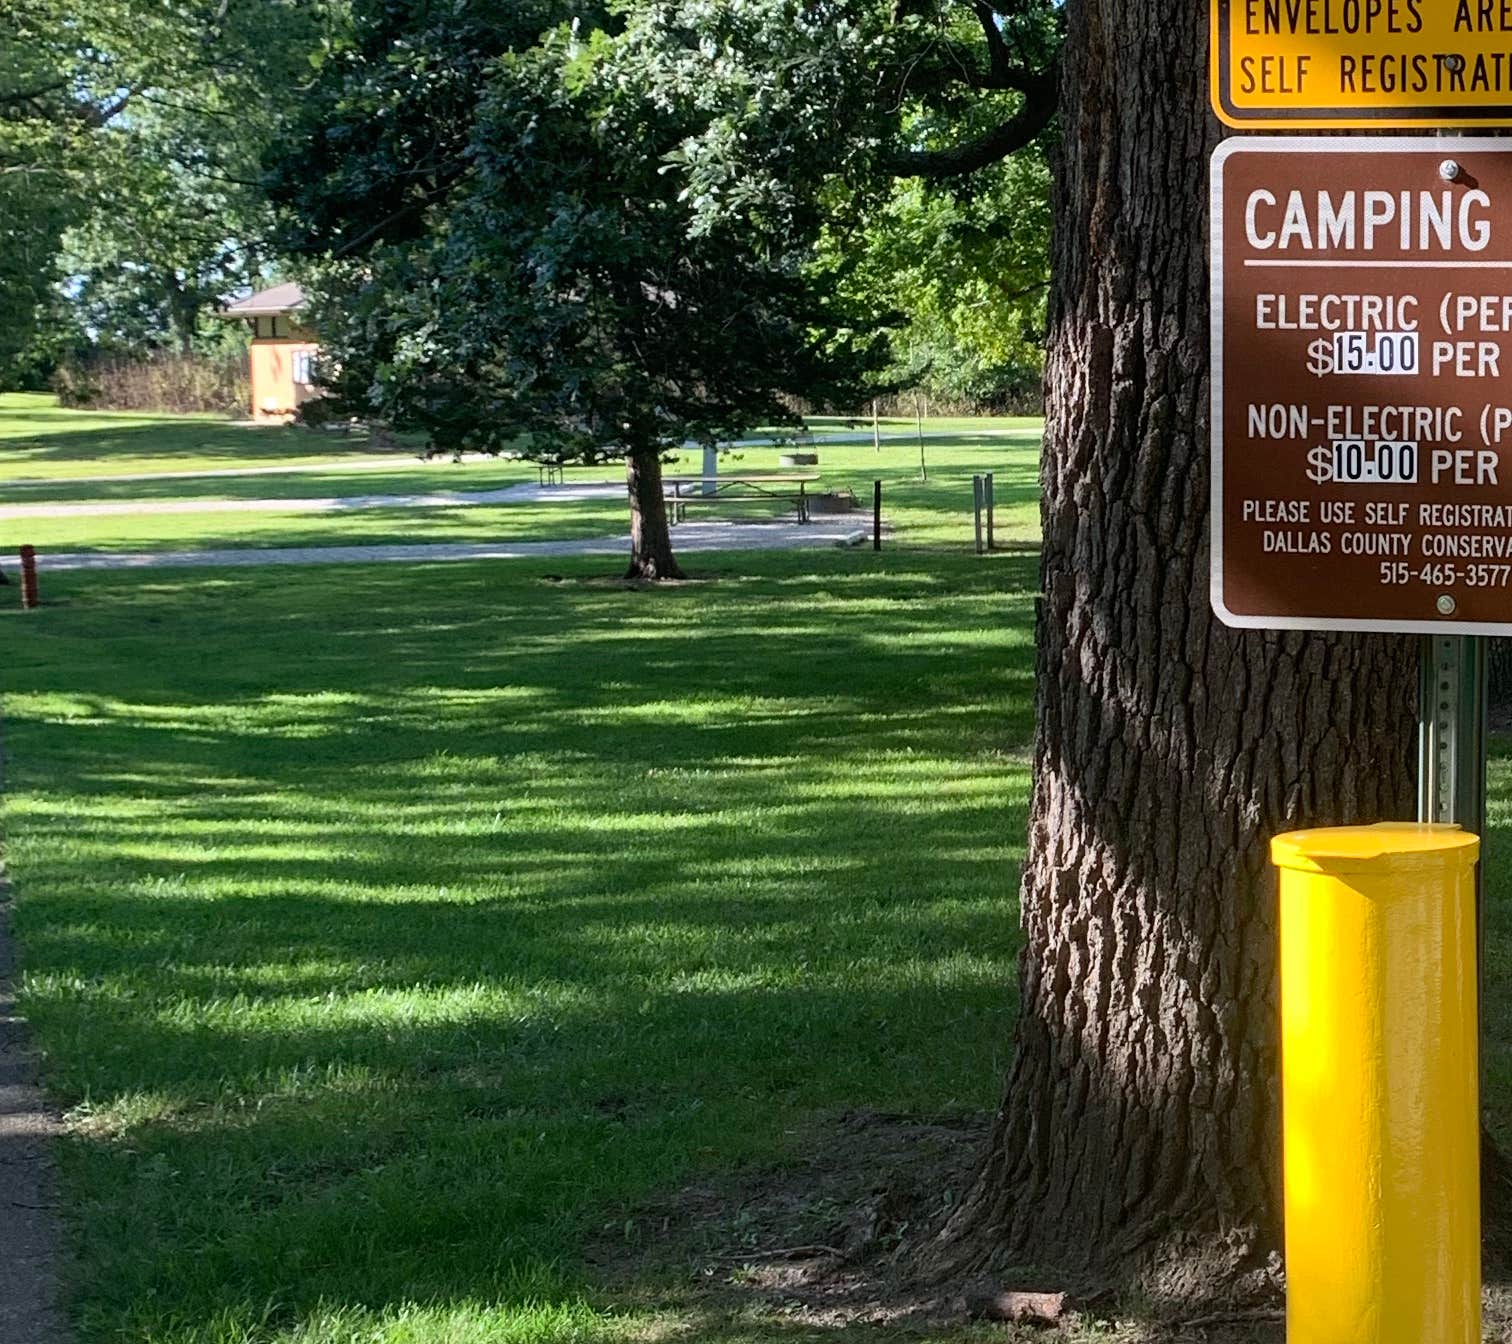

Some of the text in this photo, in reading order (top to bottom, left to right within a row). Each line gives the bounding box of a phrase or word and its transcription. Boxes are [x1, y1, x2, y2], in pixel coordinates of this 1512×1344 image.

[1240, 55, 1310, 94] SELF
[1245, 189, 1491, 251] CAMPING
[1256, 294, 1419, 330] ELECTRIC
[1433, 342, 1500, 377] PER
[1248, 403, 1463, 442] NON-ELECTRIC
[1432, 451, 1498, 485] PER
[1243, 501, 1310, 523] PLEASE
[1320, 502, 1355, 524] USE
[1365, 503, 1409, 525] SELF
[1263, 531, 1331, 554] DALLAS
[1341, 533, 1412, 555] COUNTY
[1380, 563, 1512, 587] 515-465-3577
